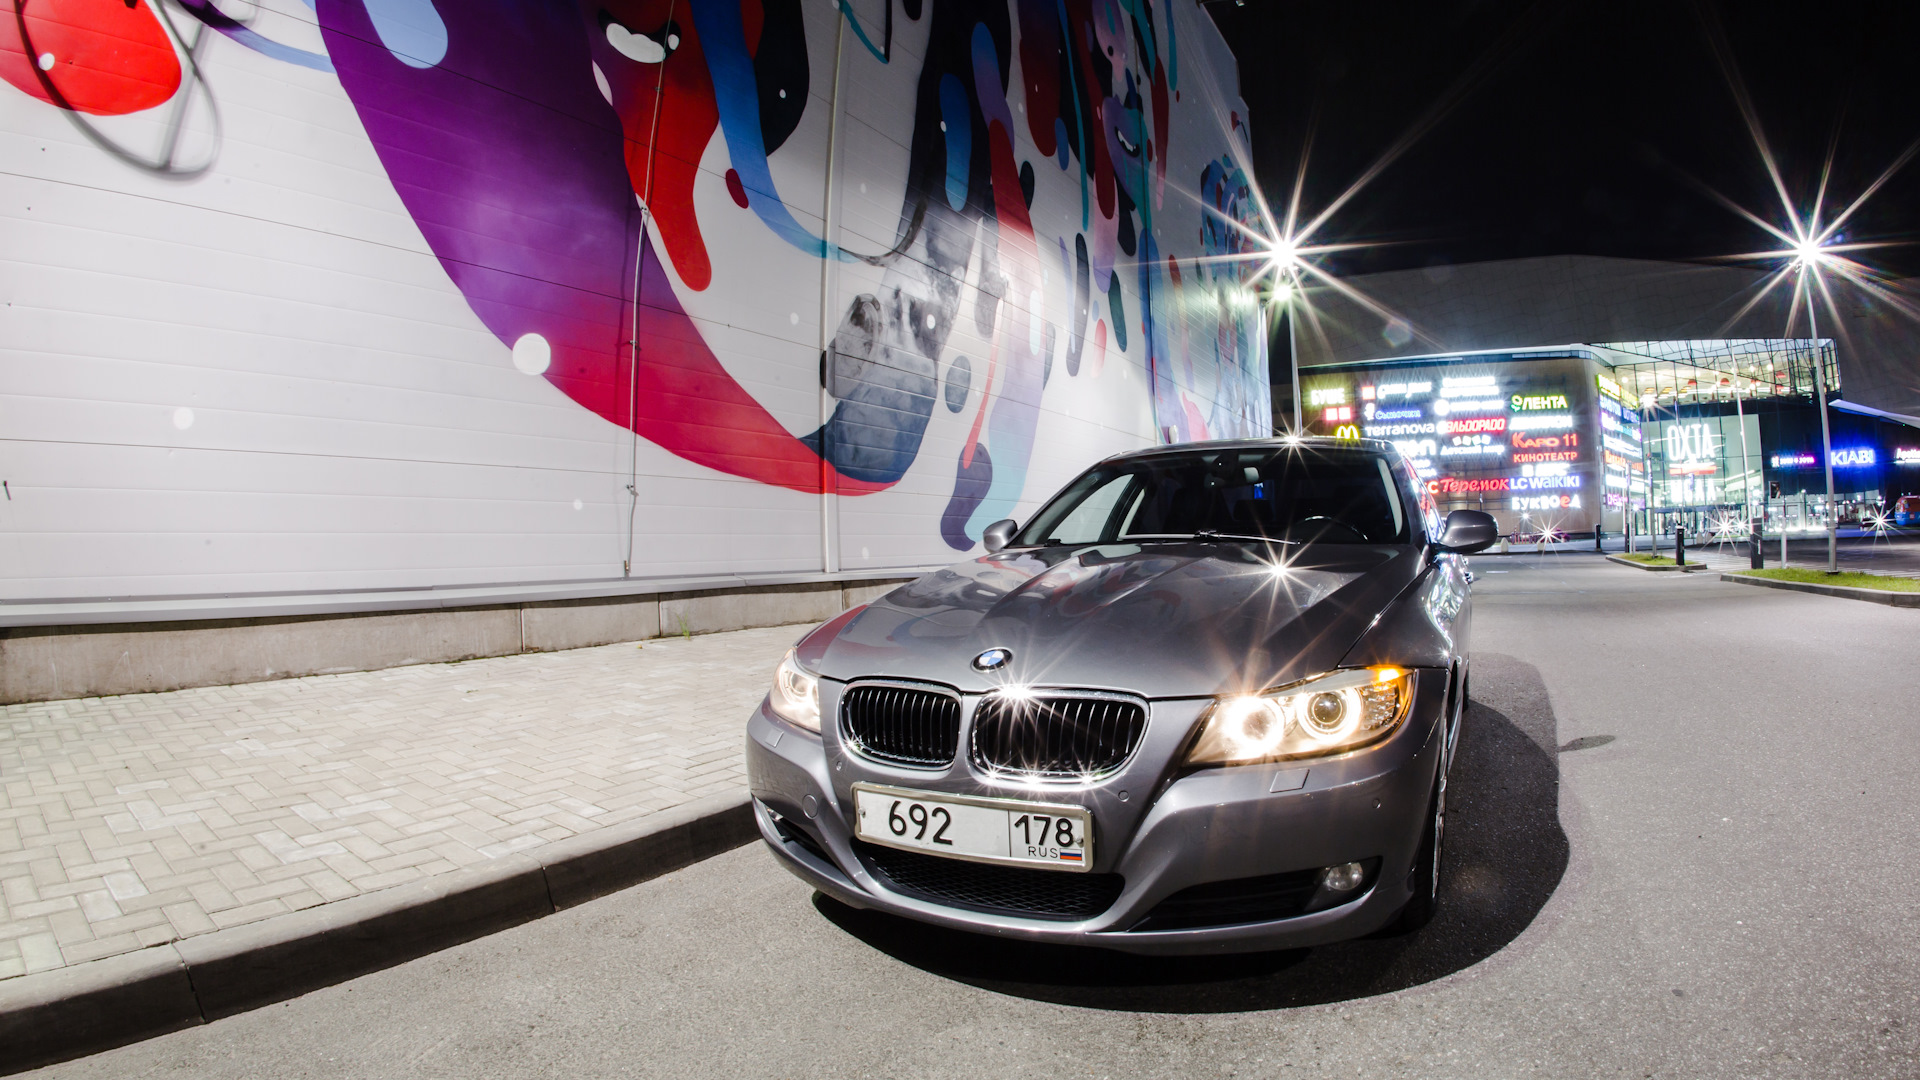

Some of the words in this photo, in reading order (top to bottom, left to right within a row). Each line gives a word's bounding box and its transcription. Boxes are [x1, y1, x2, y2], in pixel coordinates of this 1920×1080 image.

[1522, 395, 1568, 410] ЛЕНТА
[1562, 433, 1578, 447] 11
[1513, 451, 1578, 463] КИНОТЕАТР
[1830, 449, 1874, 466] KIABI
[1440, 477, 1510, 494] Теремок
[1510, 477, 1528, 490] LC
[889, 800, 953, 846] 692
[1014, 814, 1074, 848] 178
[1028, 846, 1058, 859] RUS
